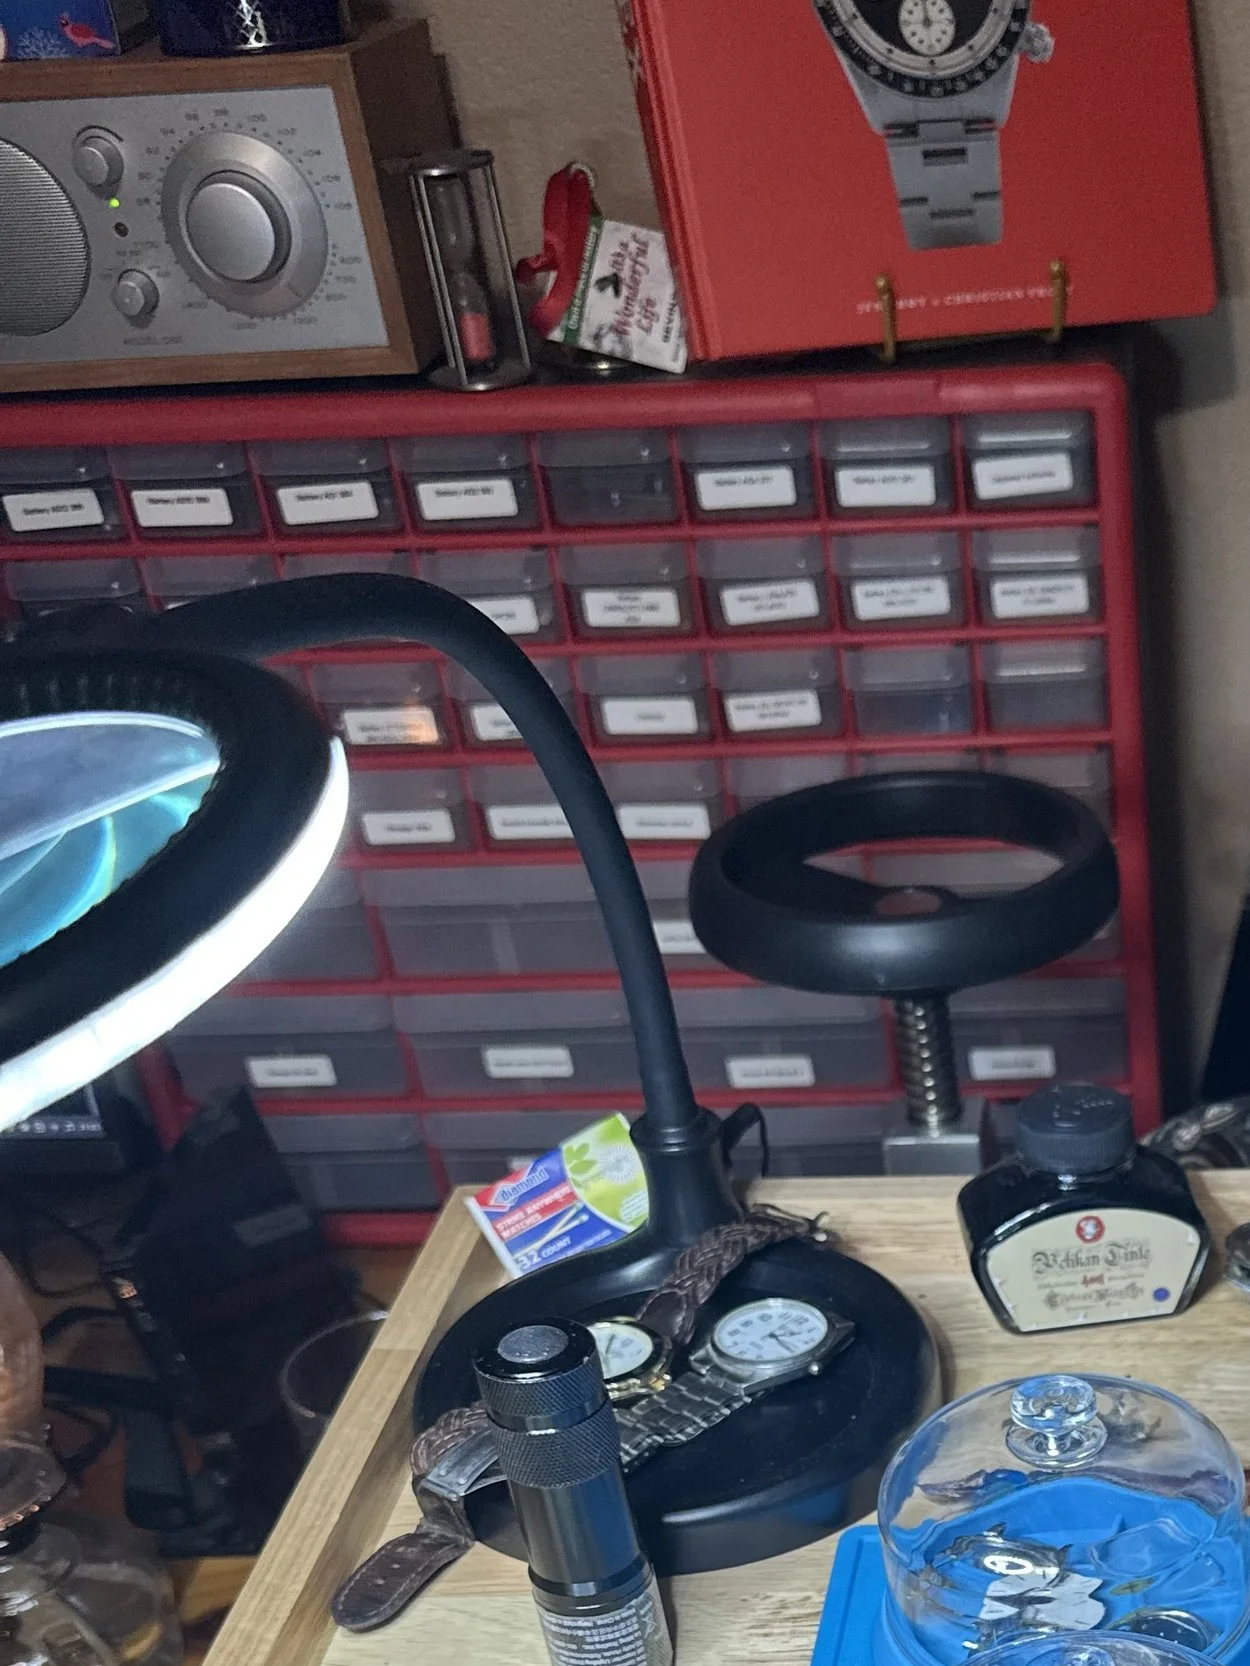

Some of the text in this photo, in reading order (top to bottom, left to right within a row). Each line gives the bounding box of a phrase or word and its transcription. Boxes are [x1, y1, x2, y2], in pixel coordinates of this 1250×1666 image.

[500, 1166, 549, 1203] diamond
[519, 1251, 542, 1270] 32
[542, 1237, 572, 1258] COUNT
